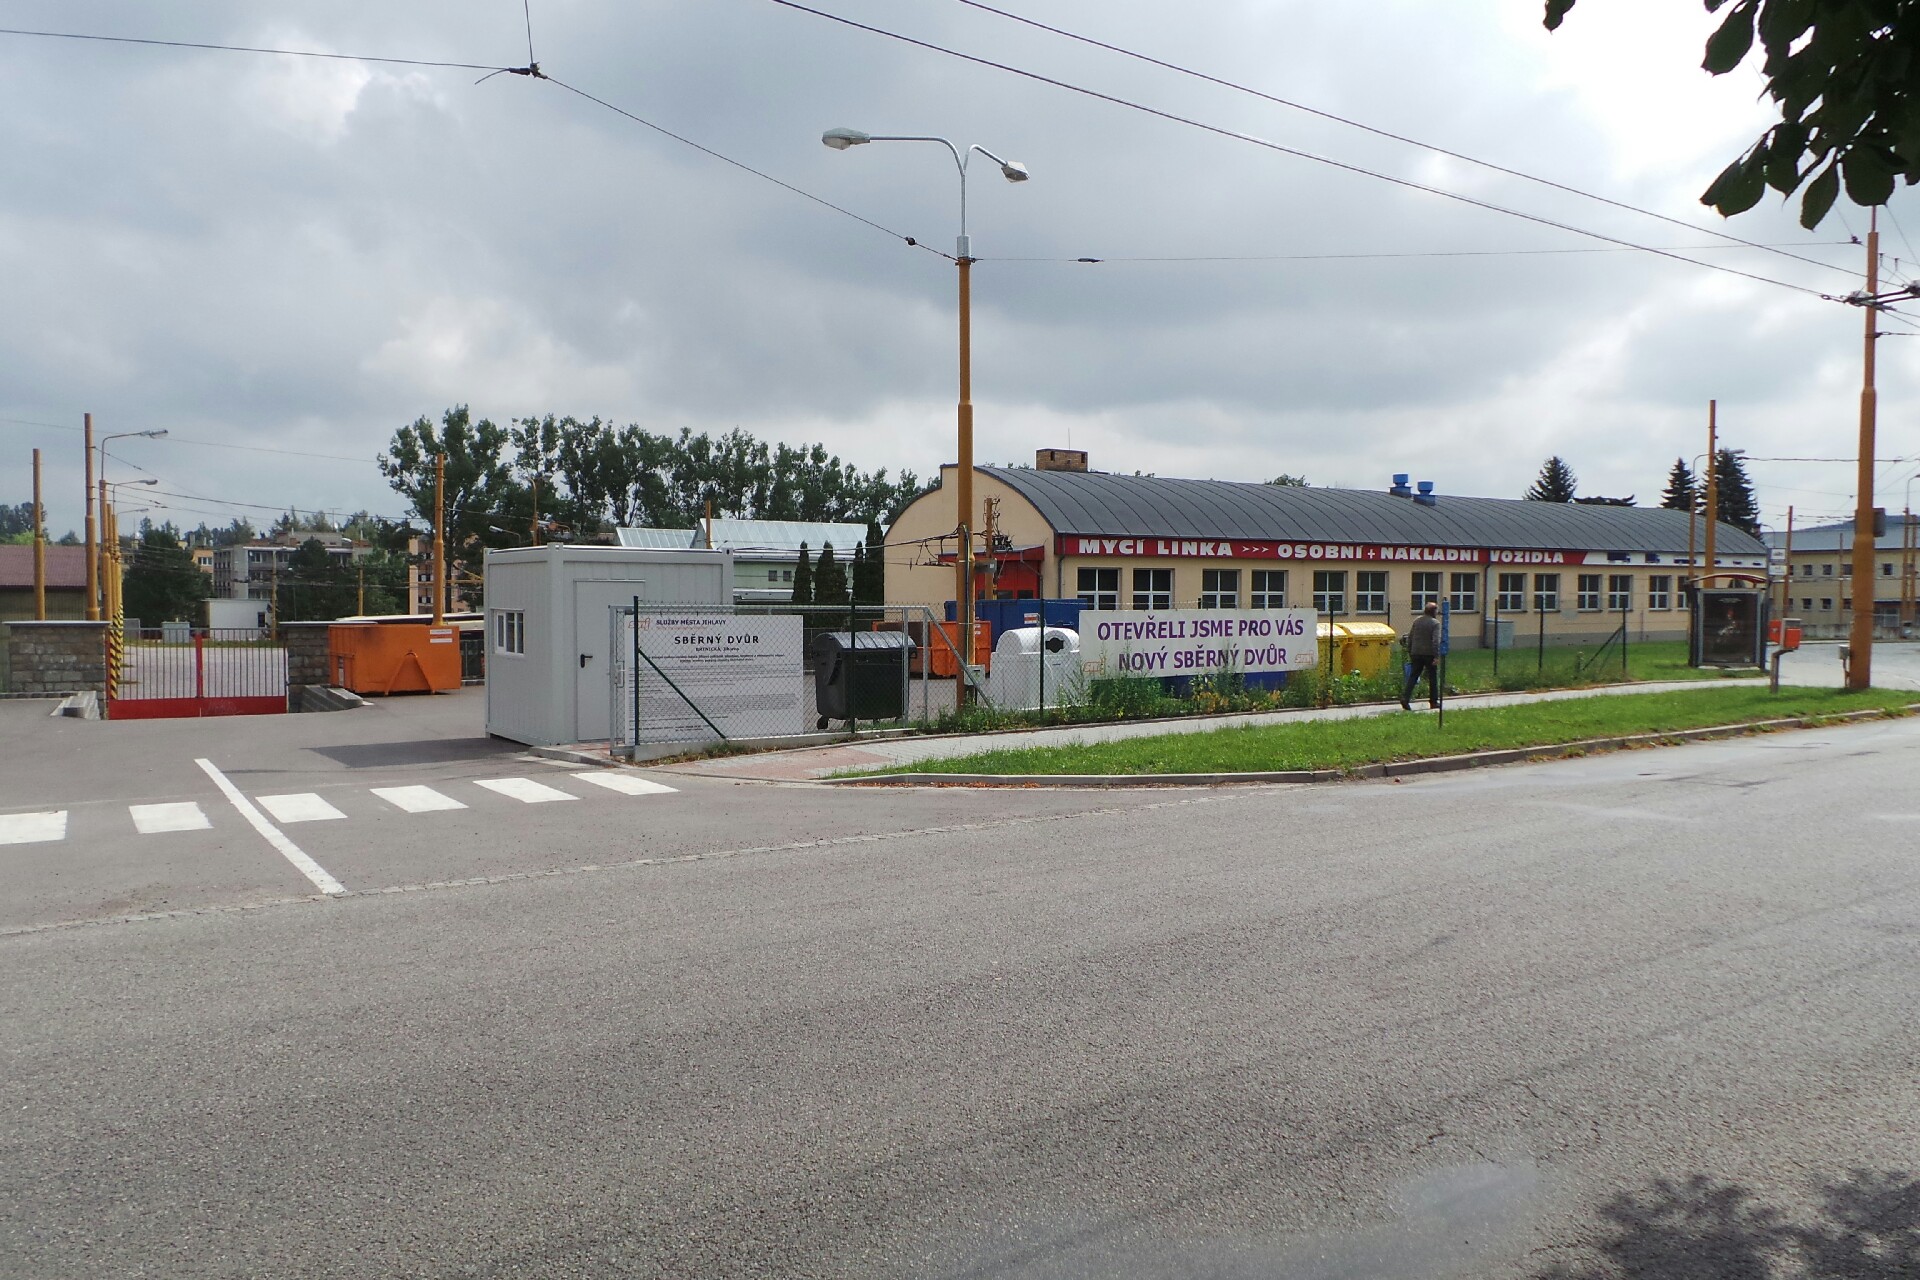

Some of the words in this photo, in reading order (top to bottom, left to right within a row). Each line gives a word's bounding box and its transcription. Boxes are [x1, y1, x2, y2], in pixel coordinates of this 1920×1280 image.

[1078, 538, 1146, 555] MYCÍ
[1157, 540, 1233, 556] LINKA
[1277, 544, 1364, 559] OSOBNÍ
[1490, 550, 1564, 564] VOZIDLA
[674, 633, 722, 645] SBĚRNÝ
[727, 634, 760, 644] DVŮR
[1097, 615, 1186, 640] OTEVŘELI
[1189, 619, 1233, 639] JSME
[1238, 618, 1271, 637] PRO
[1275, 614, 1304, 636] VÁS
[1118, 646, 1168, 671] NOVÝ
[1173, 644, 1240, 668] SBĚRNÝ
[1244, 643, 1288, 666] DVŮR
